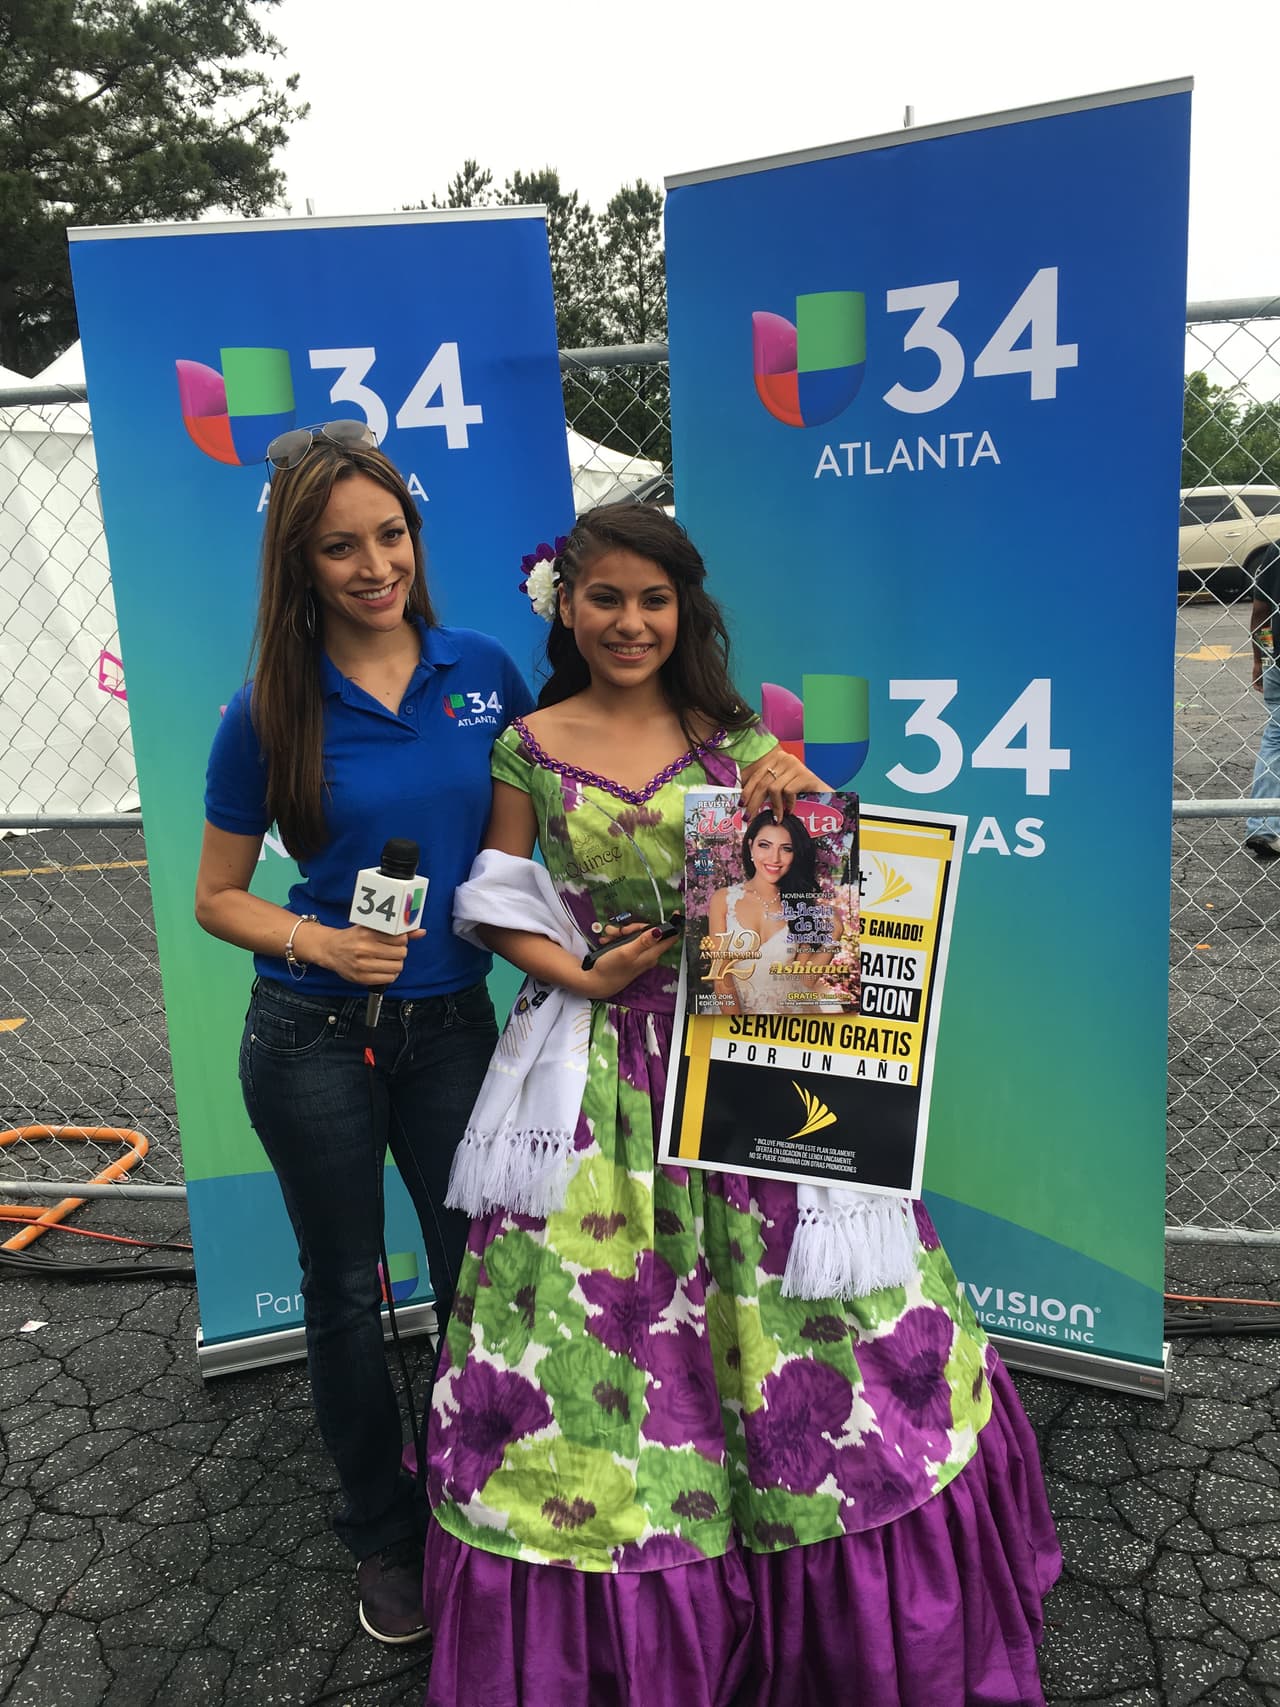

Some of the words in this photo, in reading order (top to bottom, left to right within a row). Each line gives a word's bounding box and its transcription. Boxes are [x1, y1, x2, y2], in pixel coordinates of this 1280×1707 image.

[883, 266, 1078, 414] 34
[308, 342, 483, 449] 34
[814, 431, 1001, 478] ATLANTA
[466, 691, 503, 713] 34
[458, 715, 497, 727] ATLANTA
[885, 678, 1070, 796] 34
[566, 846, 622, 878] Quince
[356, 886, 396, 922] 34
[869, 919, 924, 942] GANADO!
[699, 951, 763, 960] ANIVERSARIO
[700, 930, 761, 981] 12
[860, 952, 917, 981] RATIS
[787, 992, 818, 1000] GRATIS
[862, 985, 913, 1017] CION
[729, 1014, 834, 1046] SERVICION
[839, 1024, 912, 1057] GRATIS
[727, 1043, 777, 1065] POR
[802, 1052, 832, 1072] UN
[857, 1058, 908, 1082] AÑO
[255, 1291, 304, 1318] Par
[976, 1310, 1057, 1337] ICATIONS
[1064, 1327, 1095, 1344] INC
